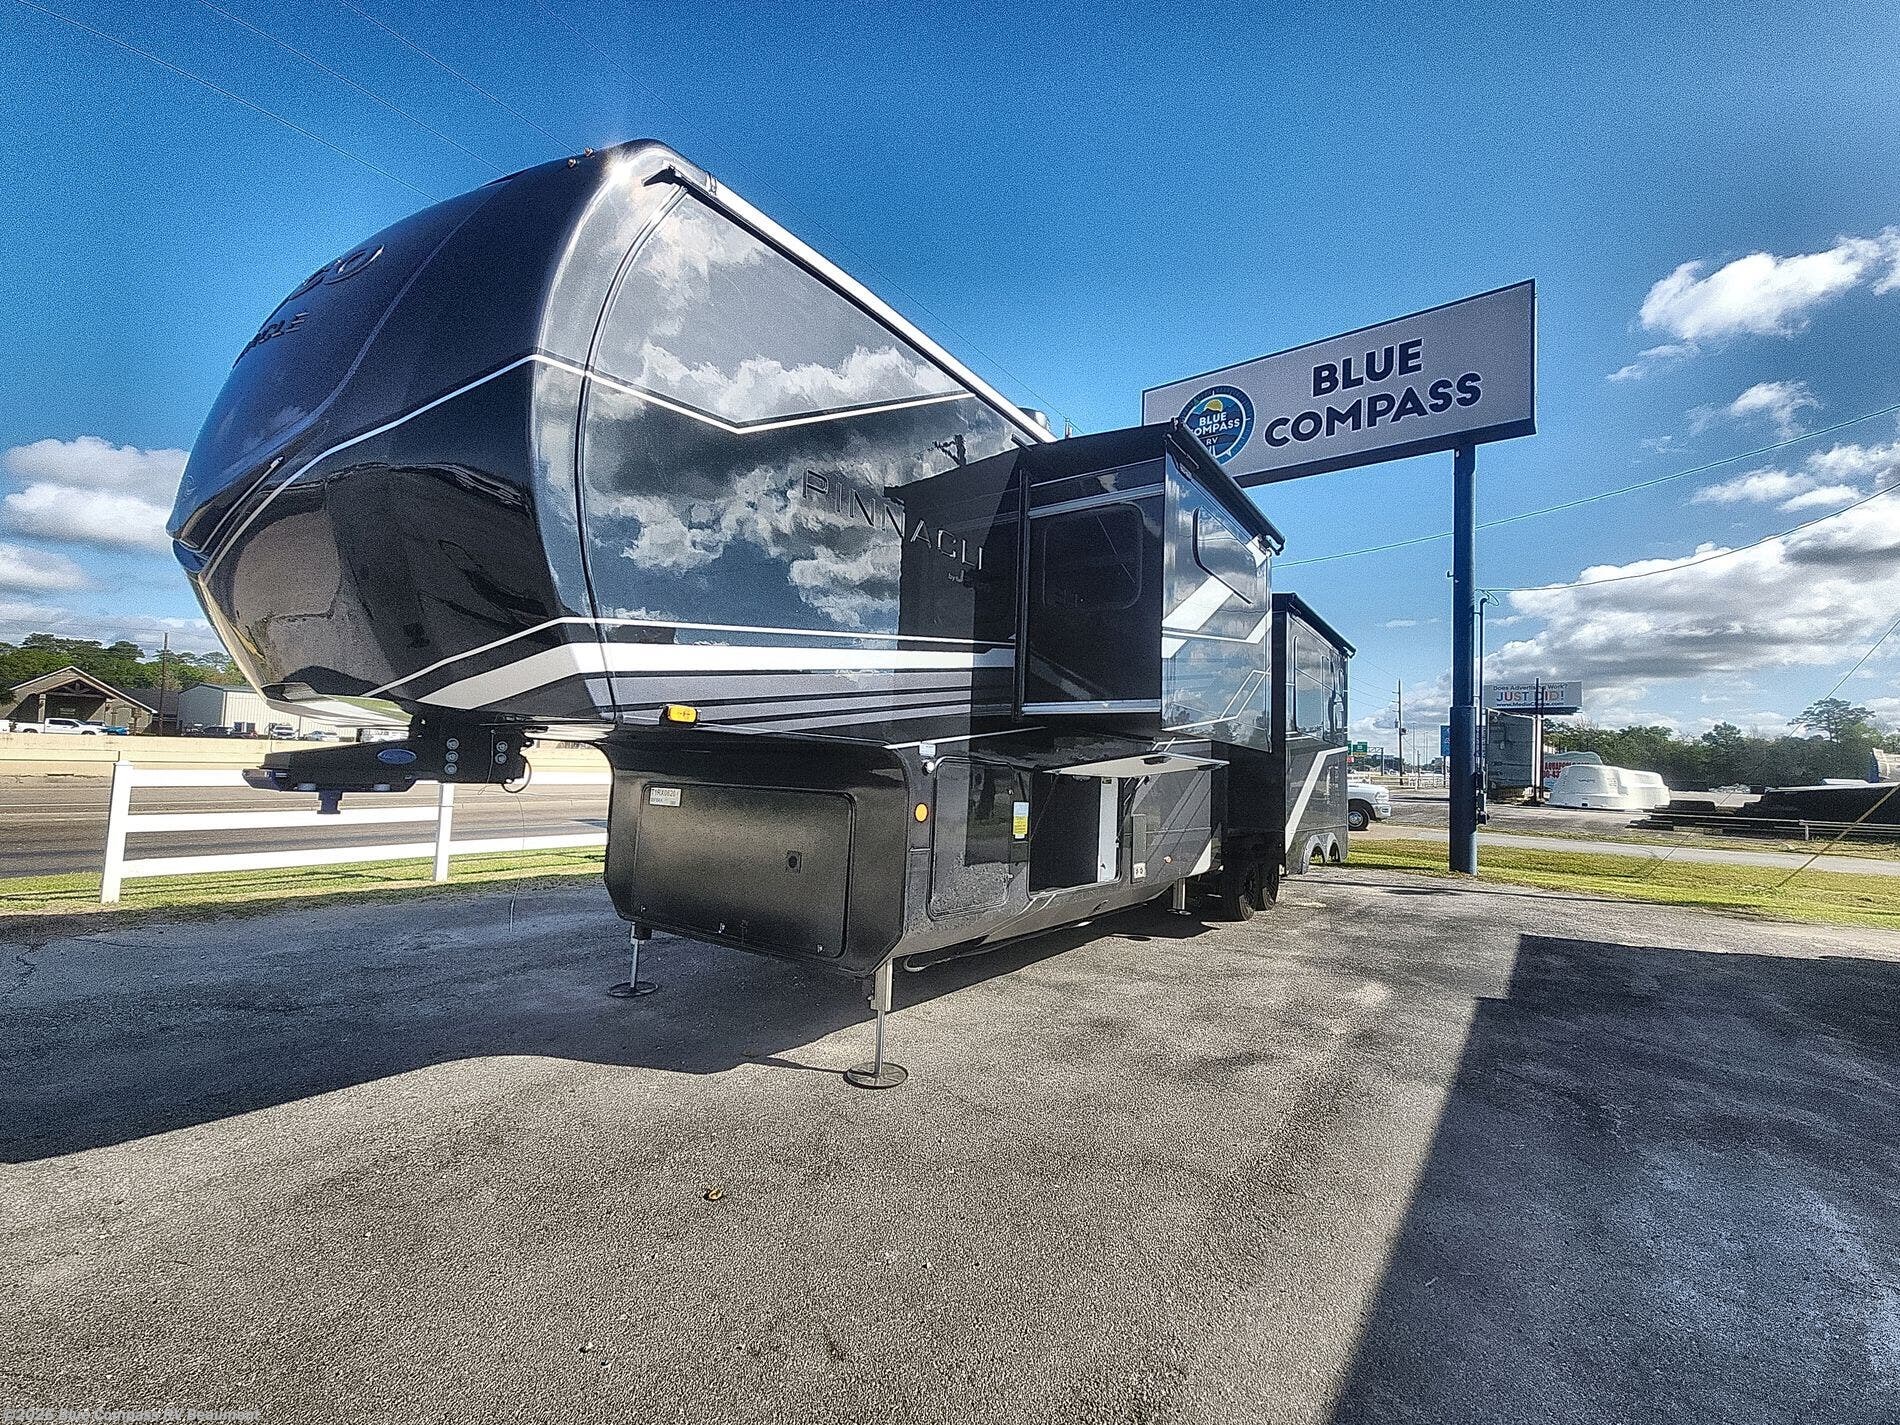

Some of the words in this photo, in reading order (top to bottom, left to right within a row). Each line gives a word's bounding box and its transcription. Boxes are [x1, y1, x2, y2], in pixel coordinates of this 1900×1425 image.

[1311, 338, 1424, 398] BLUE
[1263, 372, 1483, 448] COMPASS
[1190, 418, 1241, 436] OMPASS
[1199, 411, 1228, 427] BLUE
[1206, 437, 1219, 446] RV
[1548, 682, 1568, 690] Work?
[1496, 691, 1529, 702] JUST
